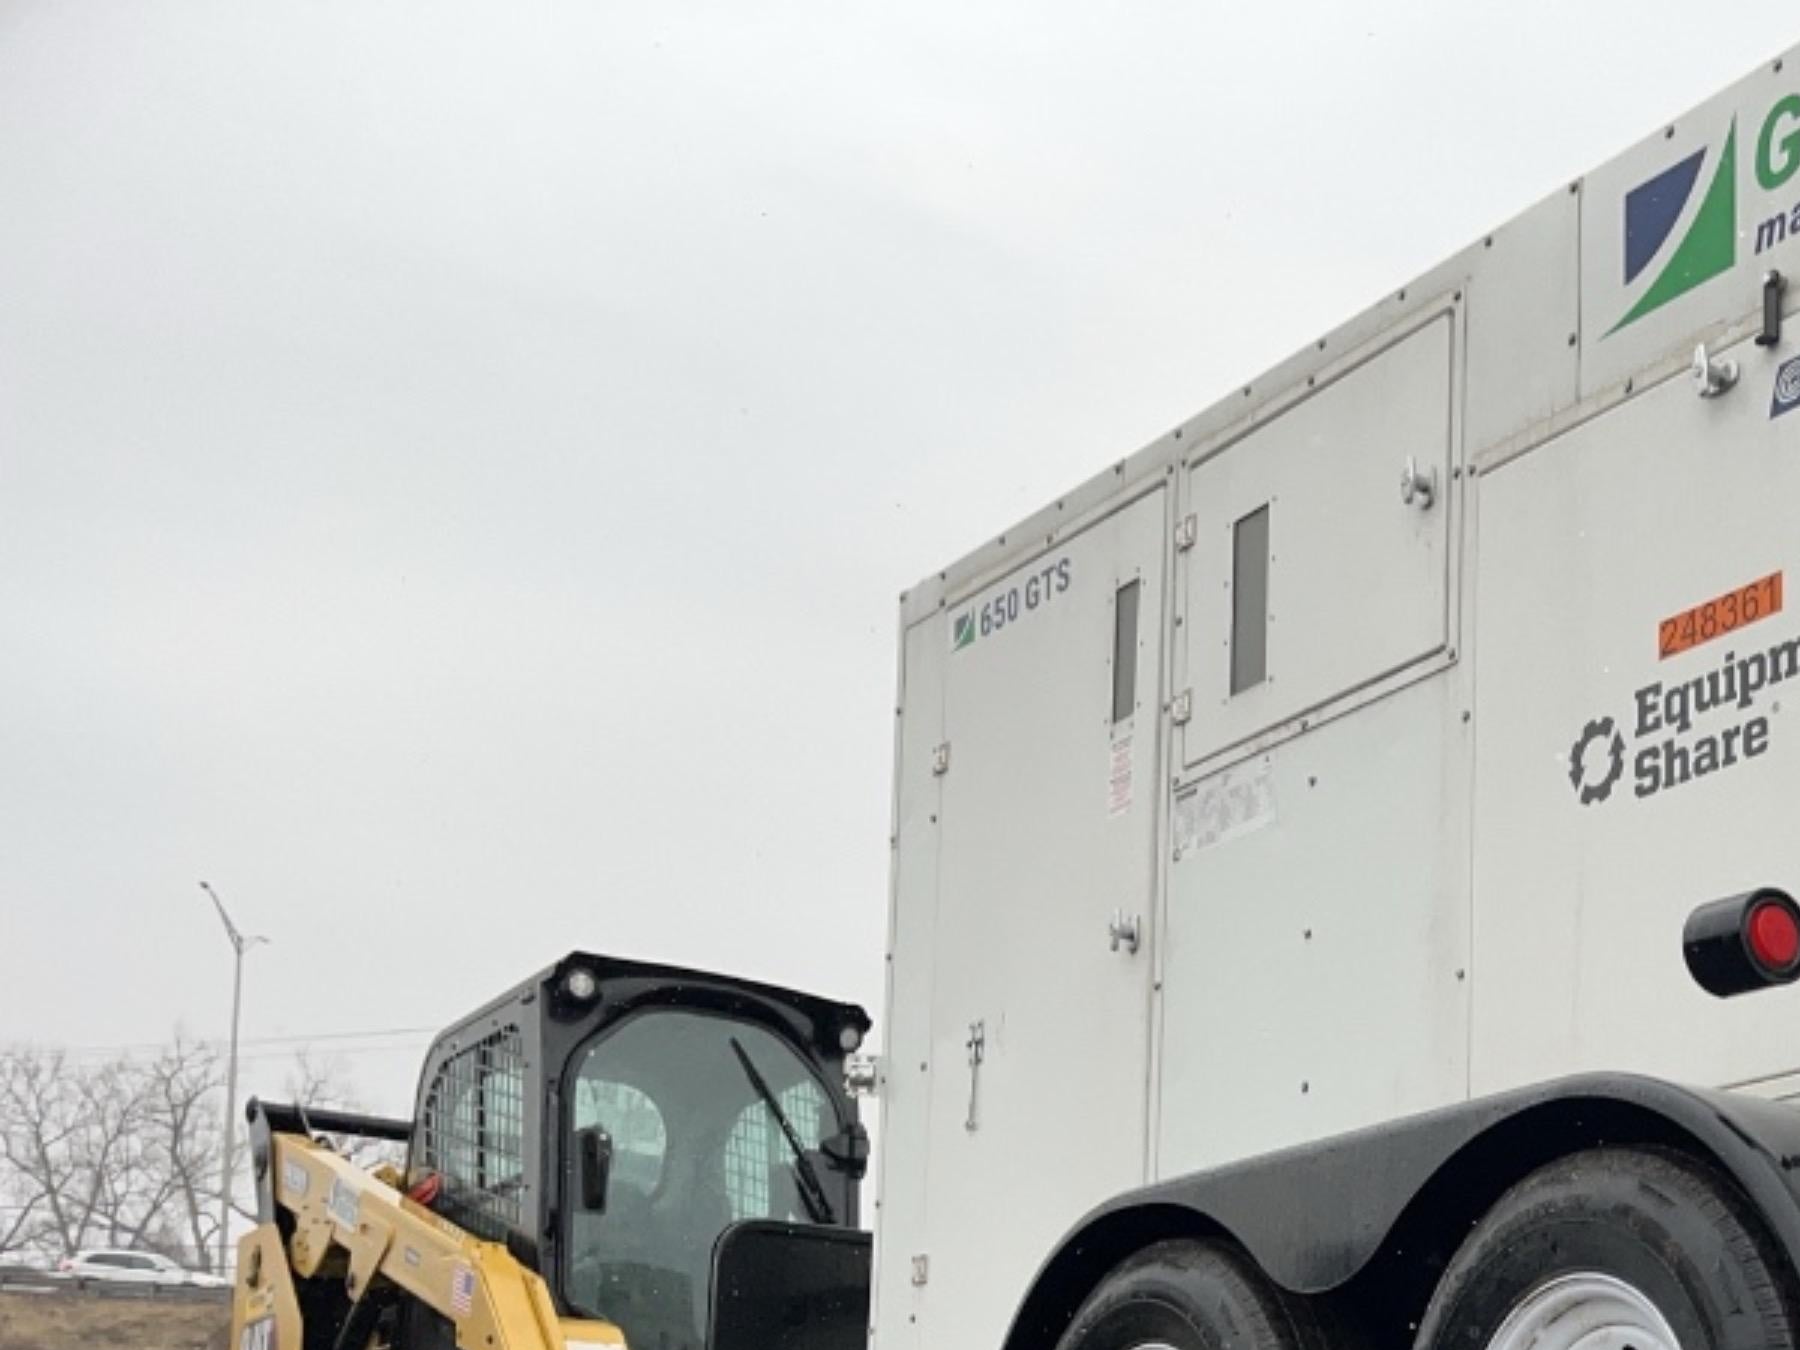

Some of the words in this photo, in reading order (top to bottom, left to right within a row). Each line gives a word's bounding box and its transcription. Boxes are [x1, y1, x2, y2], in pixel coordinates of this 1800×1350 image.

[980, 583, 1018, 638] 650
[1024, 556, 1072, 612] GTS
[1660, 573, 1780, 659] 248361
[1634, 712, 1769, 800] Share
